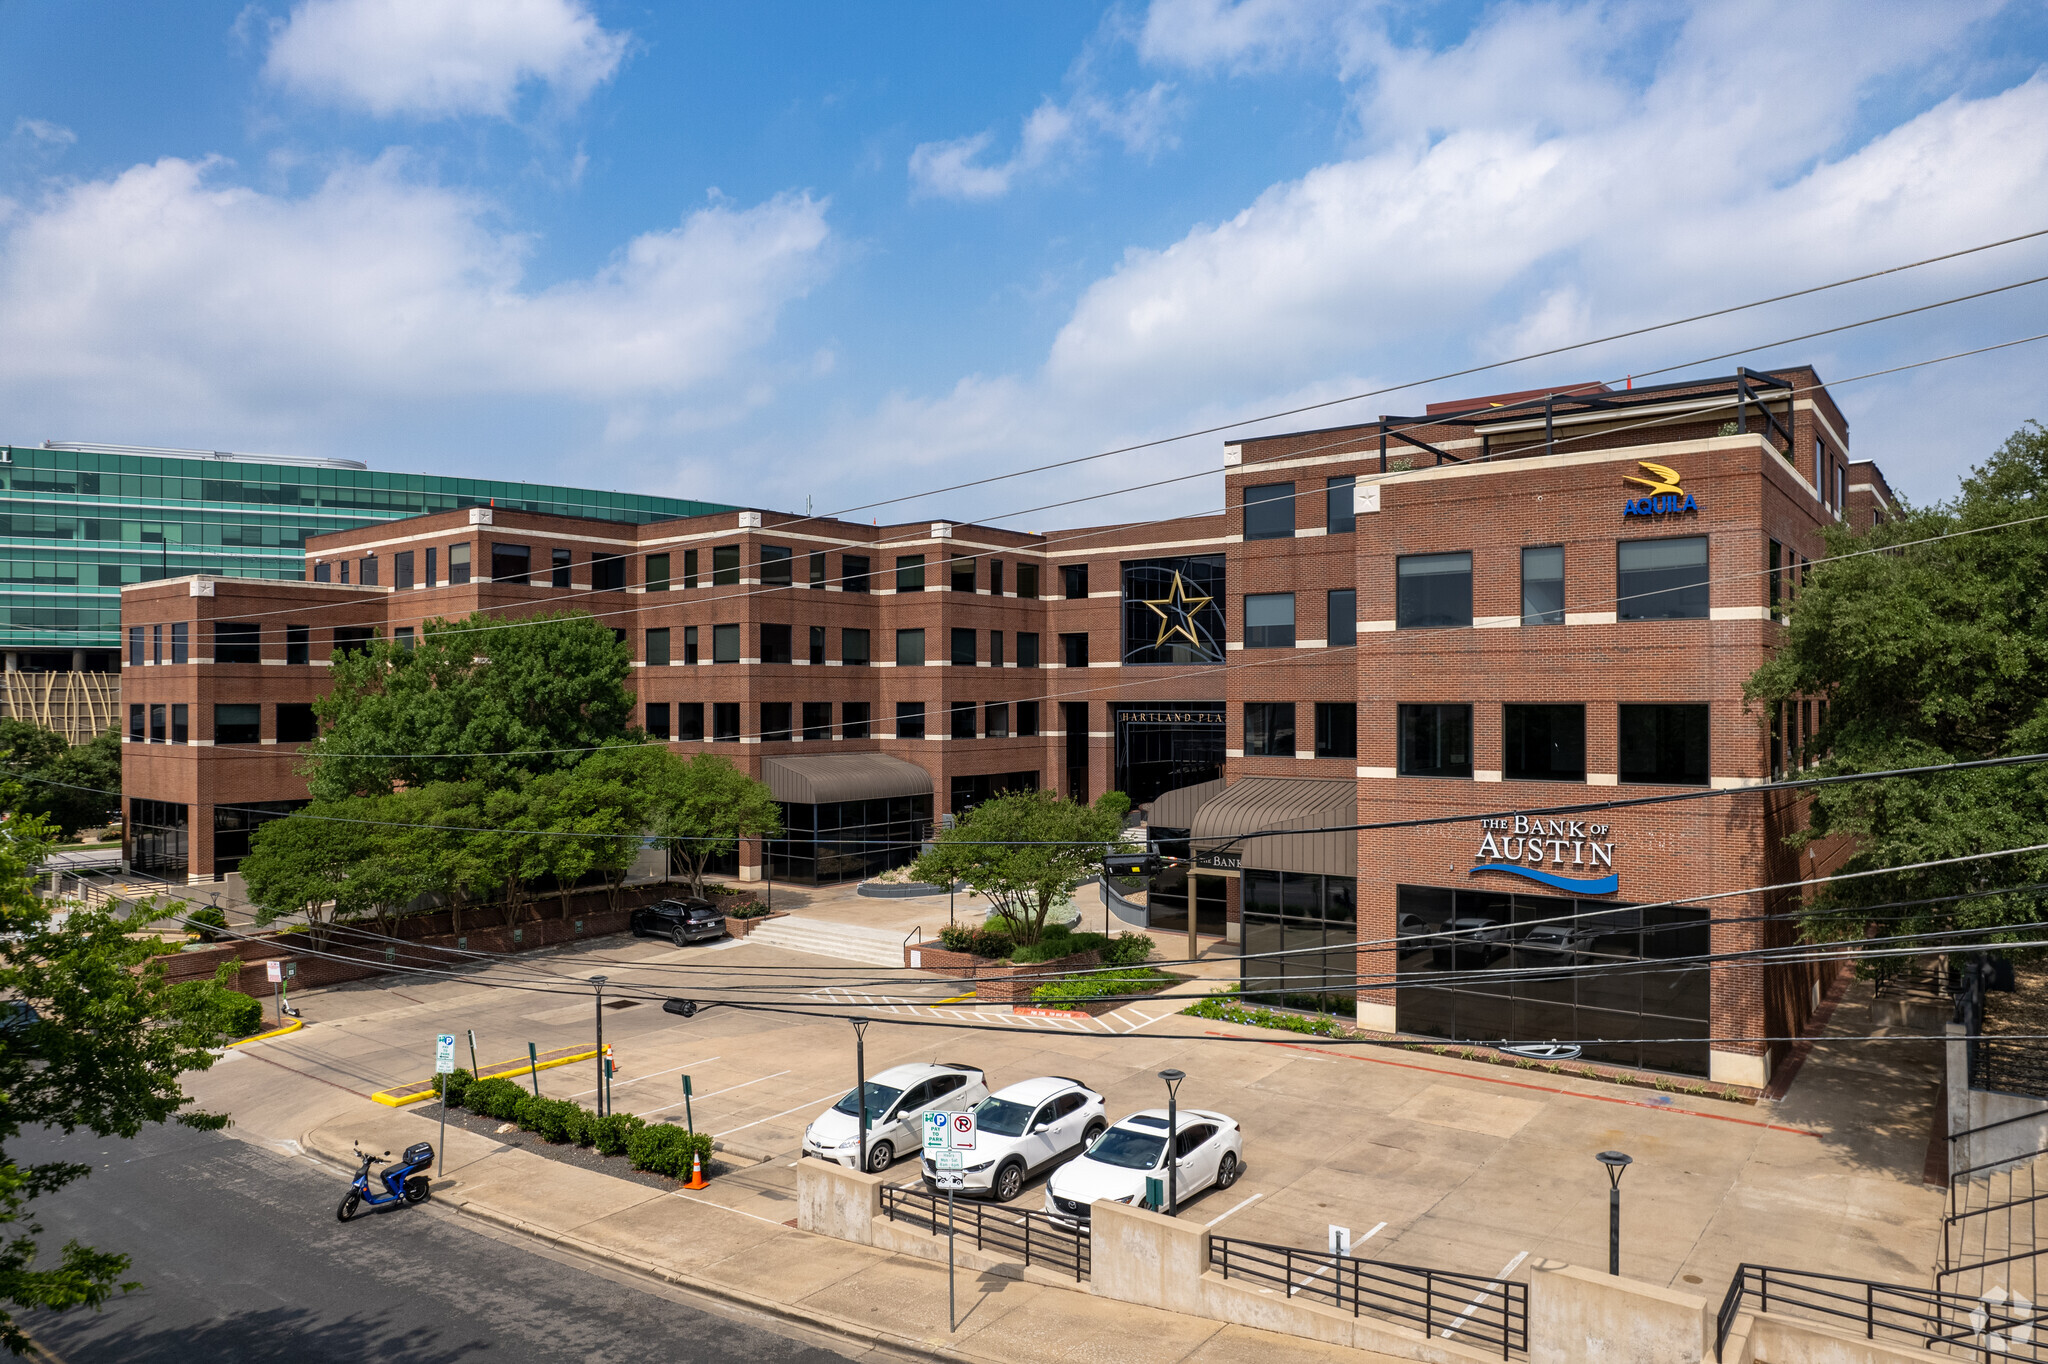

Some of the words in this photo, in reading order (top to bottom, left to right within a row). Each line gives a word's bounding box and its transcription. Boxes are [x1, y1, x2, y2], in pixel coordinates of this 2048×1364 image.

[0, 451, 12, 462] L
[1623, 494, 1698, 516] AQUILA
[1122, 713, 1191, 722] HARTLAND
[1199, 713, 1226, 722] PLA
[1481, 819, 1508, 829] THE
[1514, 815, 1587, 838] BANK
[1590, 824, 1609, 835] OF
[1475, 831, 1615, 868] AUSTIN
